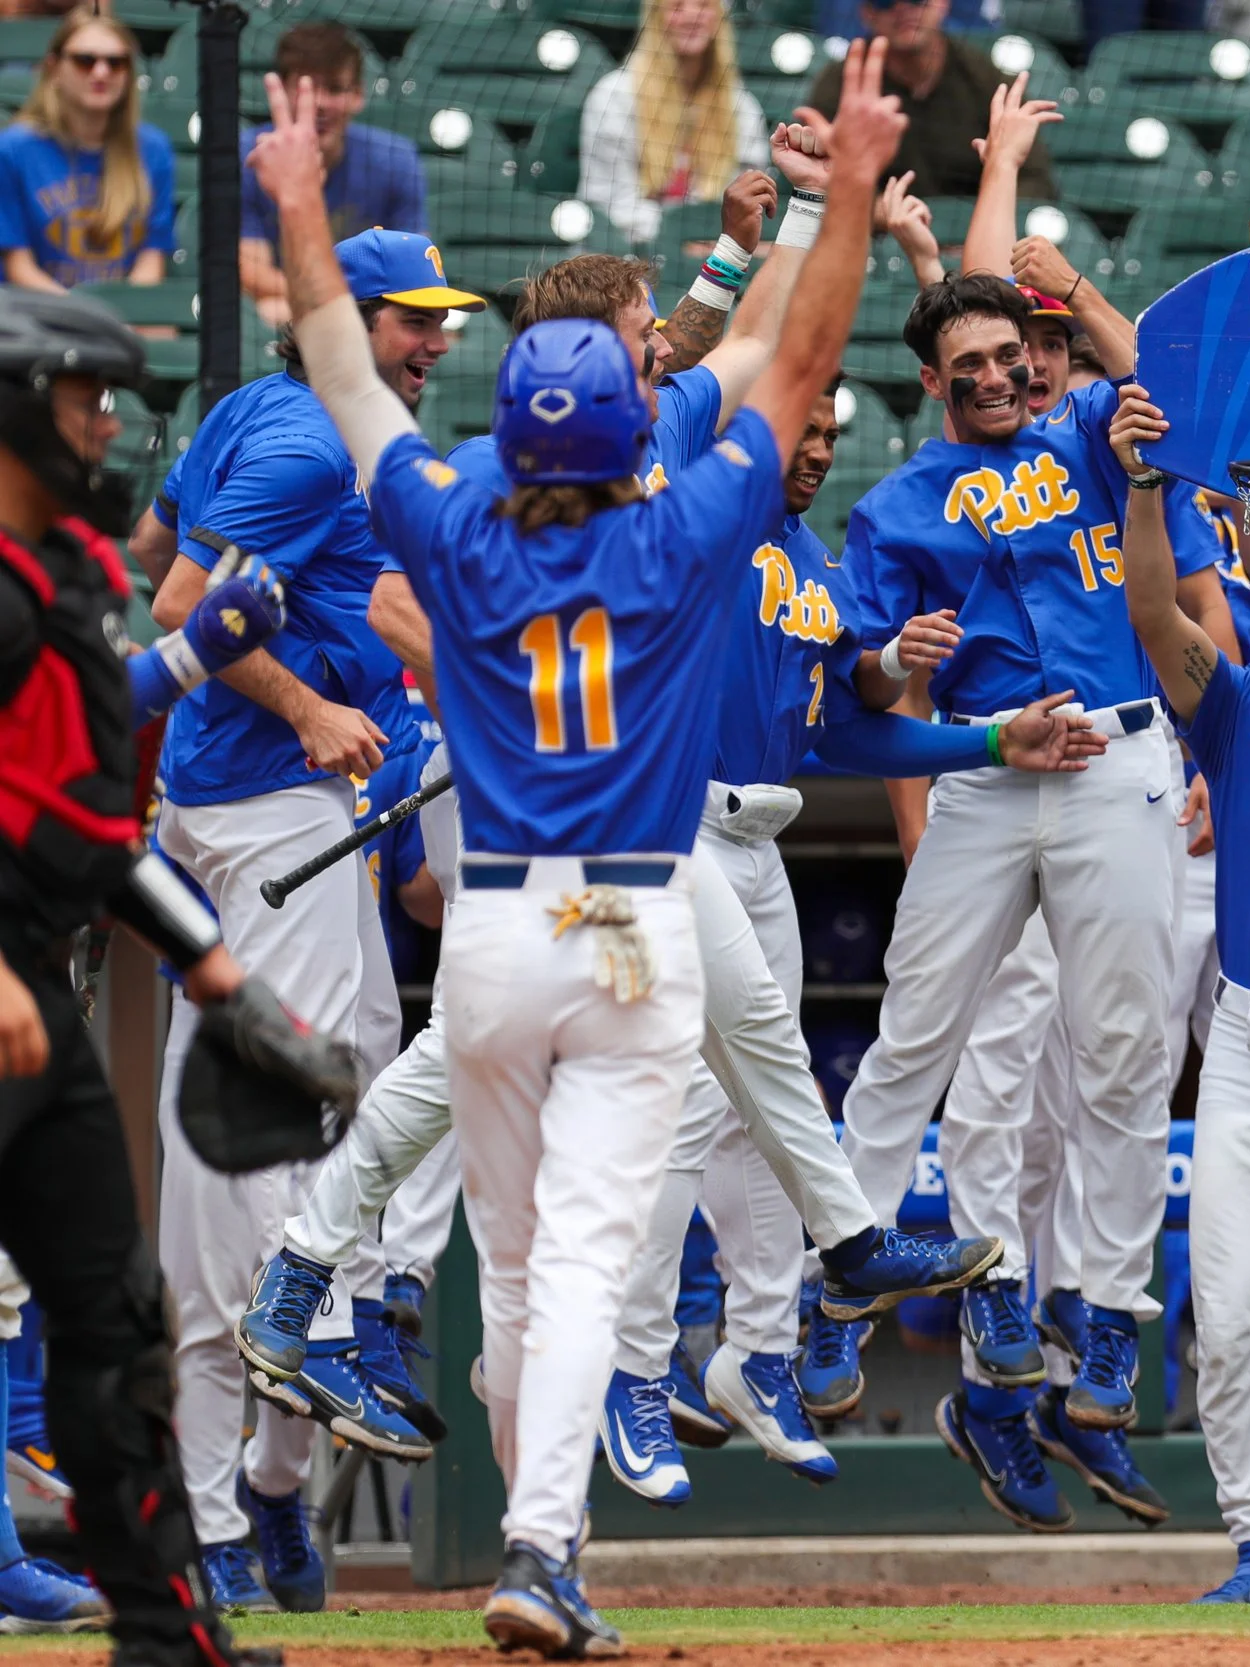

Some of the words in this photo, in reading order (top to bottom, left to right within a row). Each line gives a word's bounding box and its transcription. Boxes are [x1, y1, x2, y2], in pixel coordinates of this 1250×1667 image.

[944, 452, 1080, 544] Pitt
[752, 542, 844, 646] Pitt
[1069, 522, 1125, 593] 15
[518, 606, 618, 753] 11
